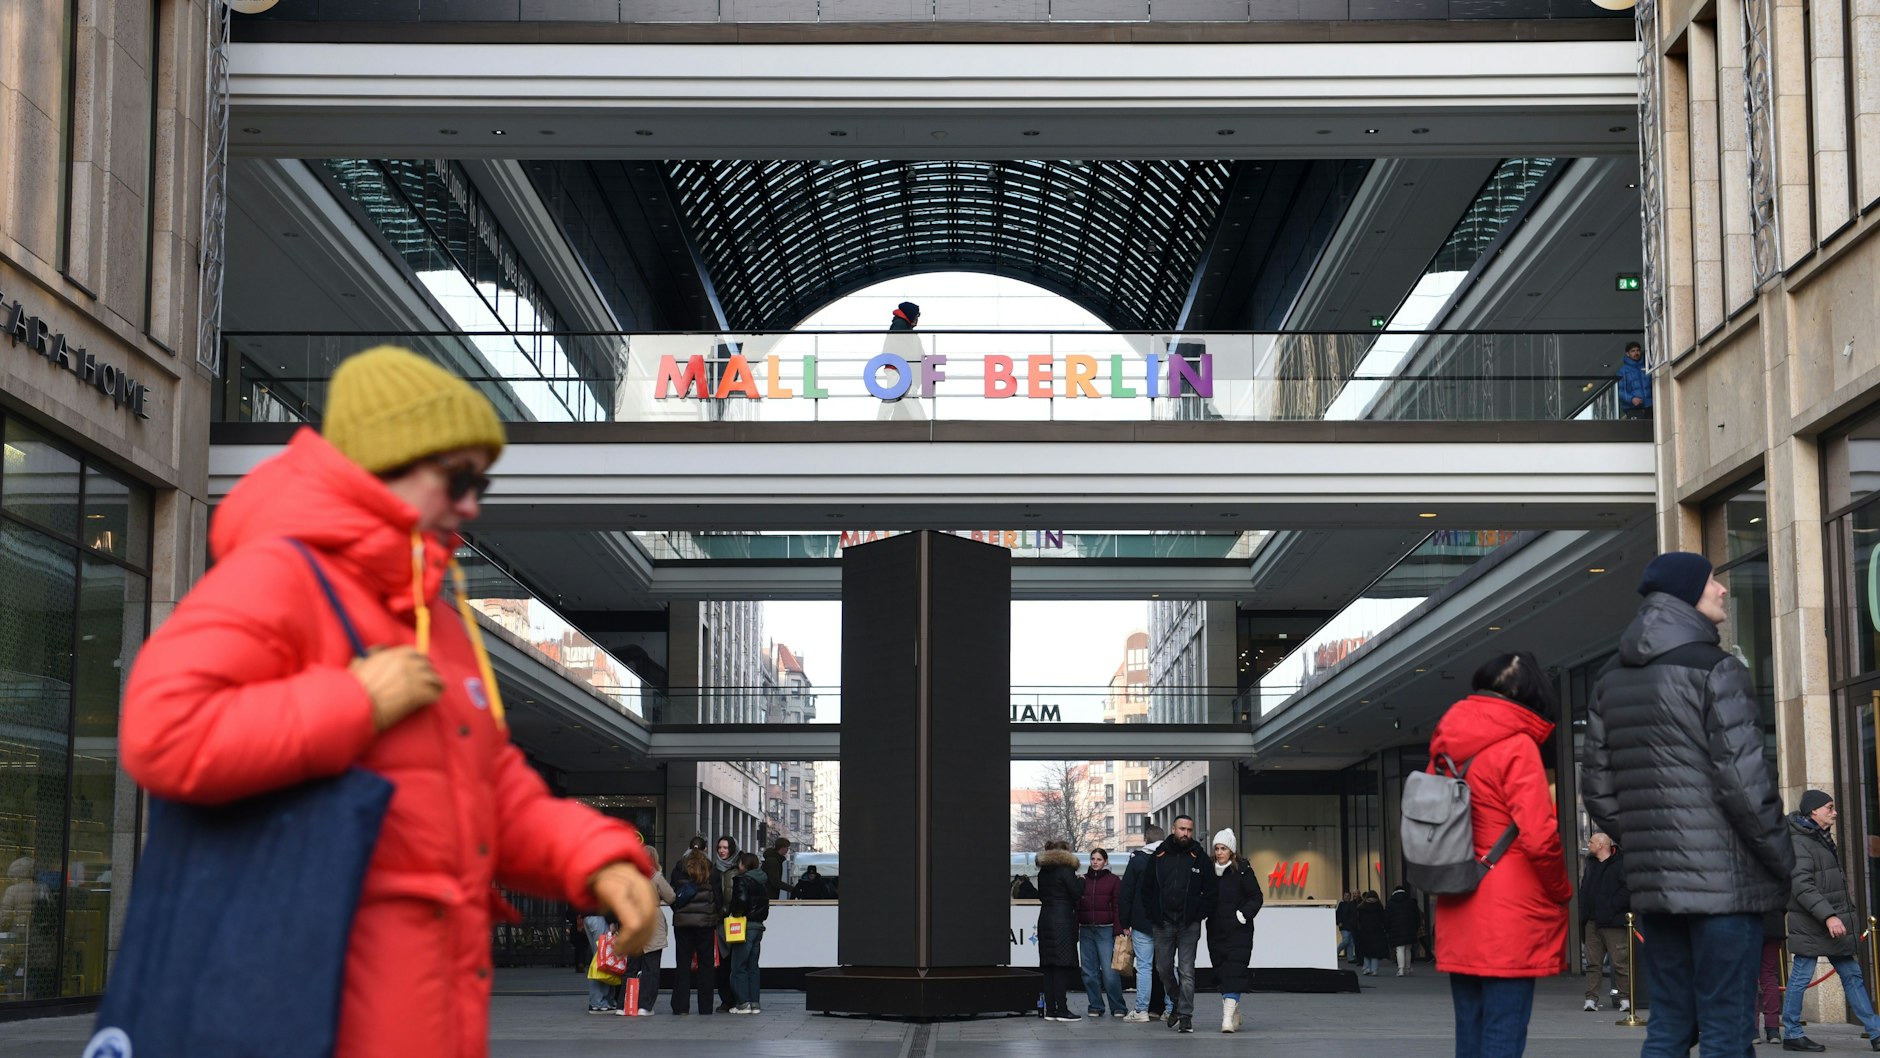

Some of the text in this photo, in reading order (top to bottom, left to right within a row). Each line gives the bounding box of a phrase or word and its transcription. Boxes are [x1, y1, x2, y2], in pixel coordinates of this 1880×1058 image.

[0, 291, 151, 420] ARA HOME
[654, 352, 1214, 402] MALL OF BERLIN
